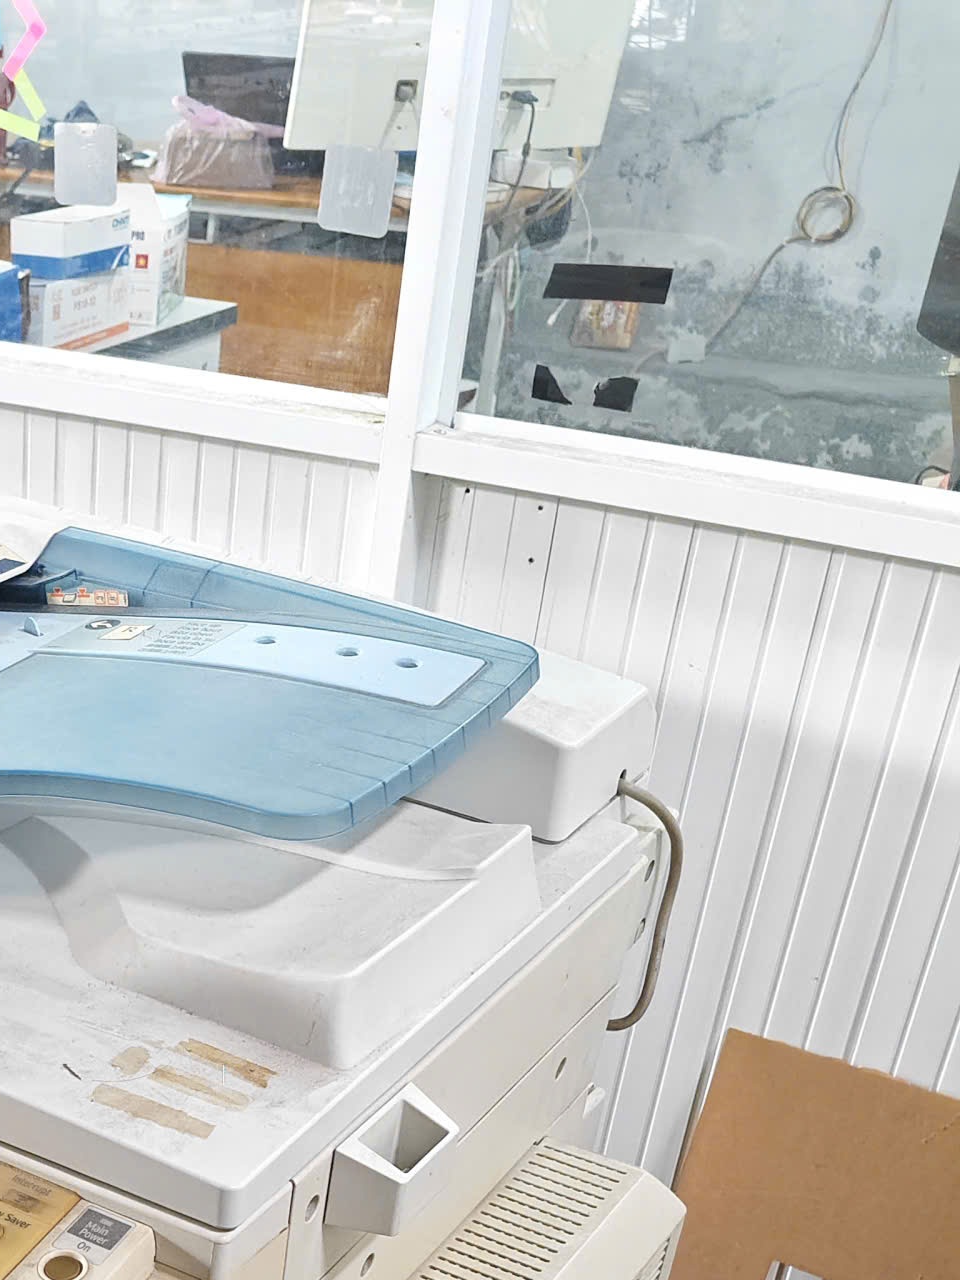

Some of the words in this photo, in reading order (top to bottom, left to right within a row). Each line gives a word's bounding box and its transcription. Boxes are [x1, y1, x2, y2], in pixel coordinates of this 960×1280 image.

[12, 1174, 53, 1197] Interrupt
[4, 1213, 32, 1230] Saver
[85, 1220, 110, 1236] Main
[78, 1228, 109, 1246] Power
[76, 1241, 92, 1253] On
